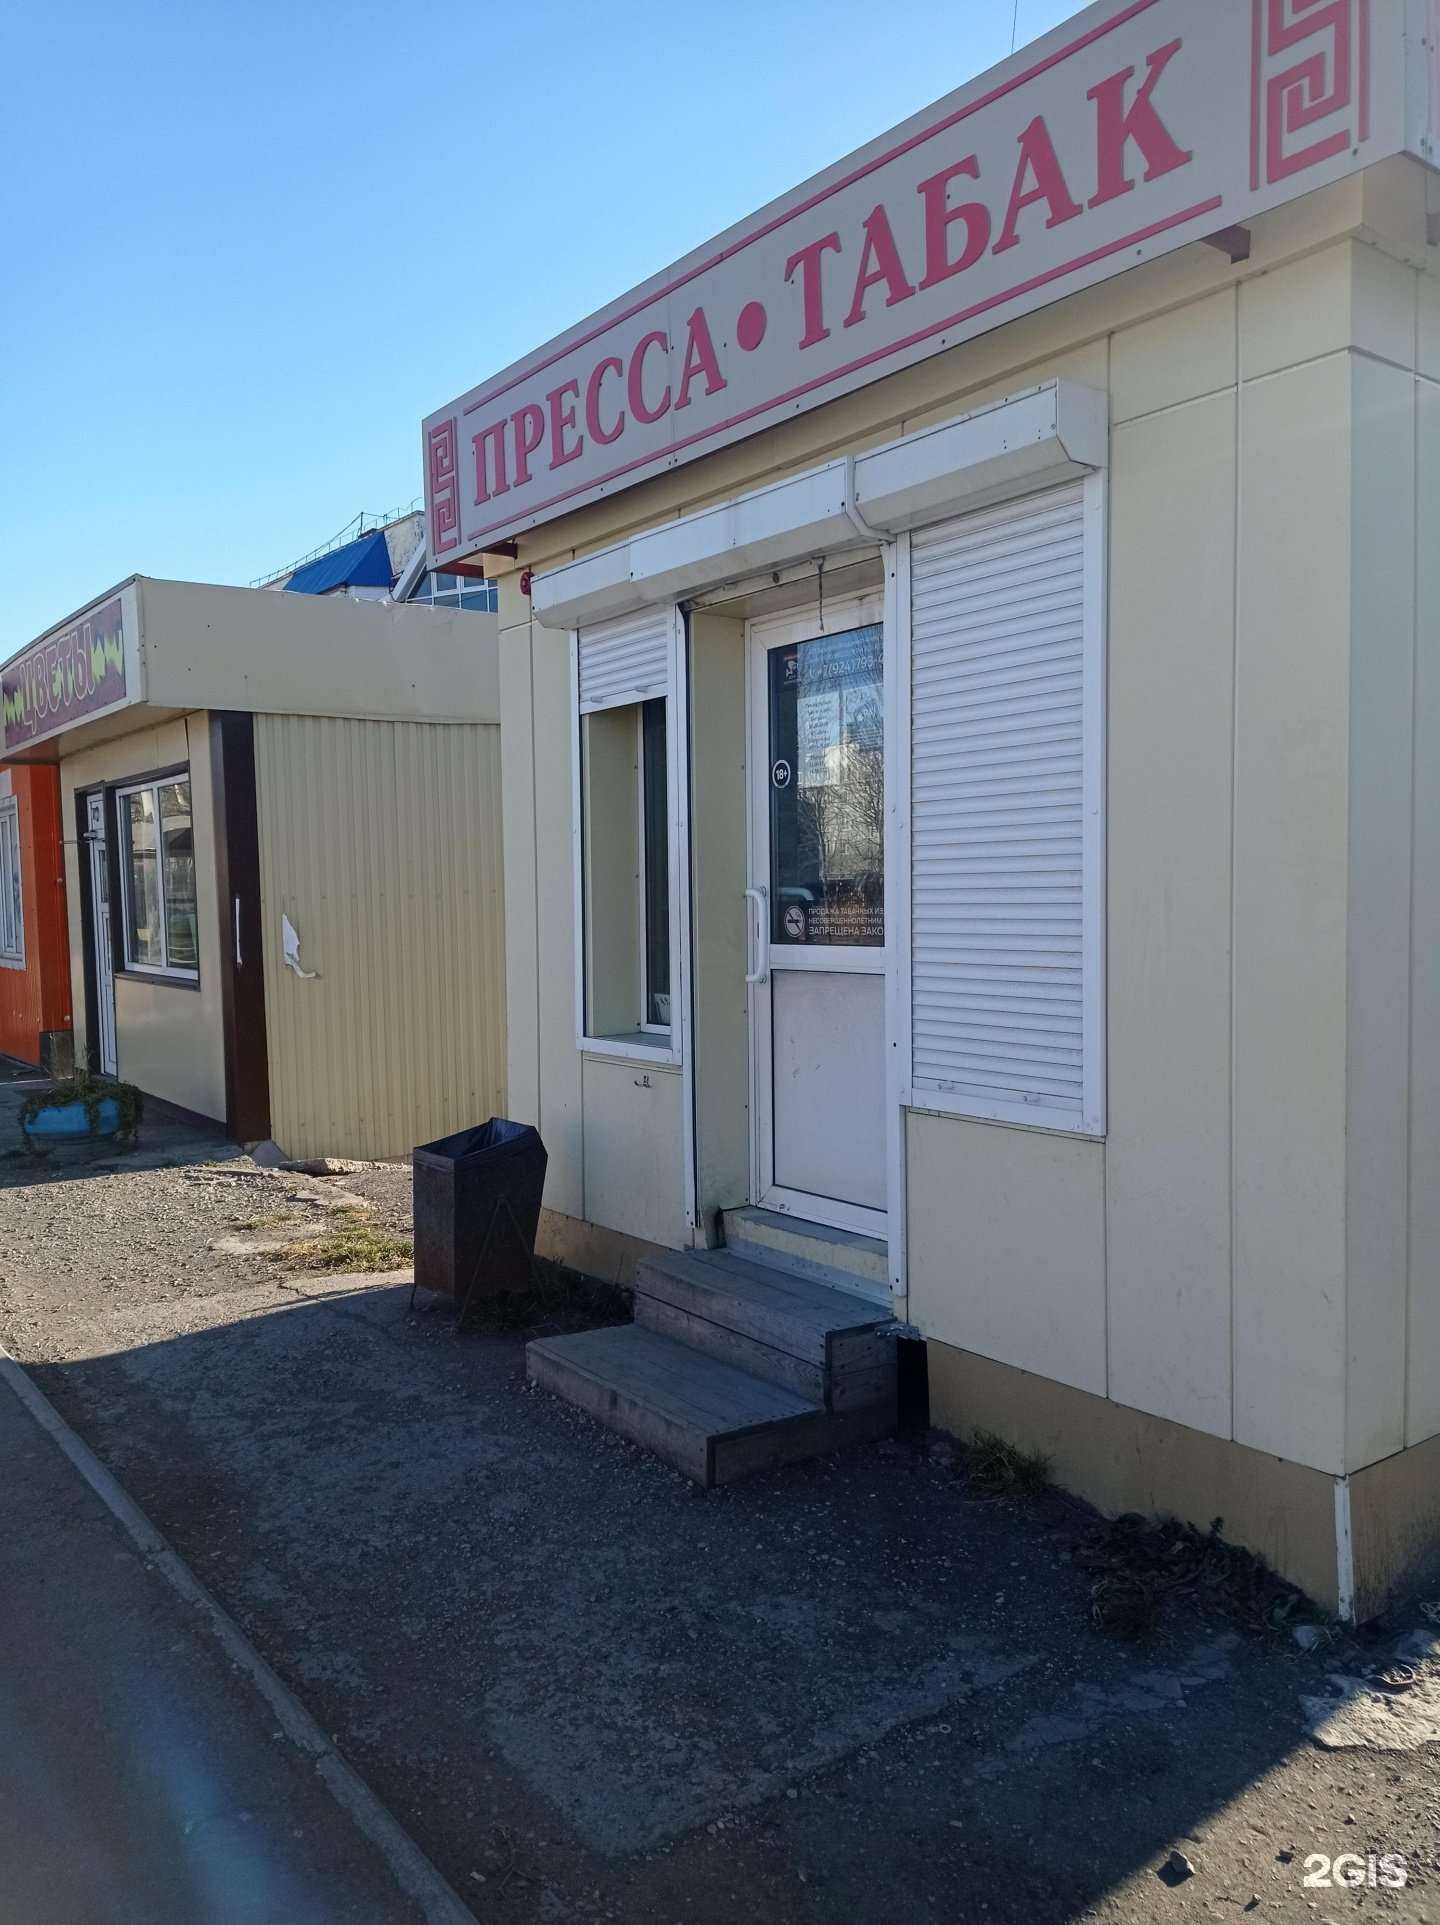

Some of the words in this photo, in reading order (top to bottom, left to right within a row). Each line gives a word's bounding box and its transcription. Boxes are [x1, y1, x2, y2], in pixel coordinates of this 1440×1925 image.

[472, 307, 727, 505] ПРЕССА
[784, 38, 1192, 350] ТАБАК
[19, 623, 95, 735] ЦВЕТЫ
[776, 769, 787, 780] 18+
[808, 927, 860, 936] ЗАПРЕЩЕНА
